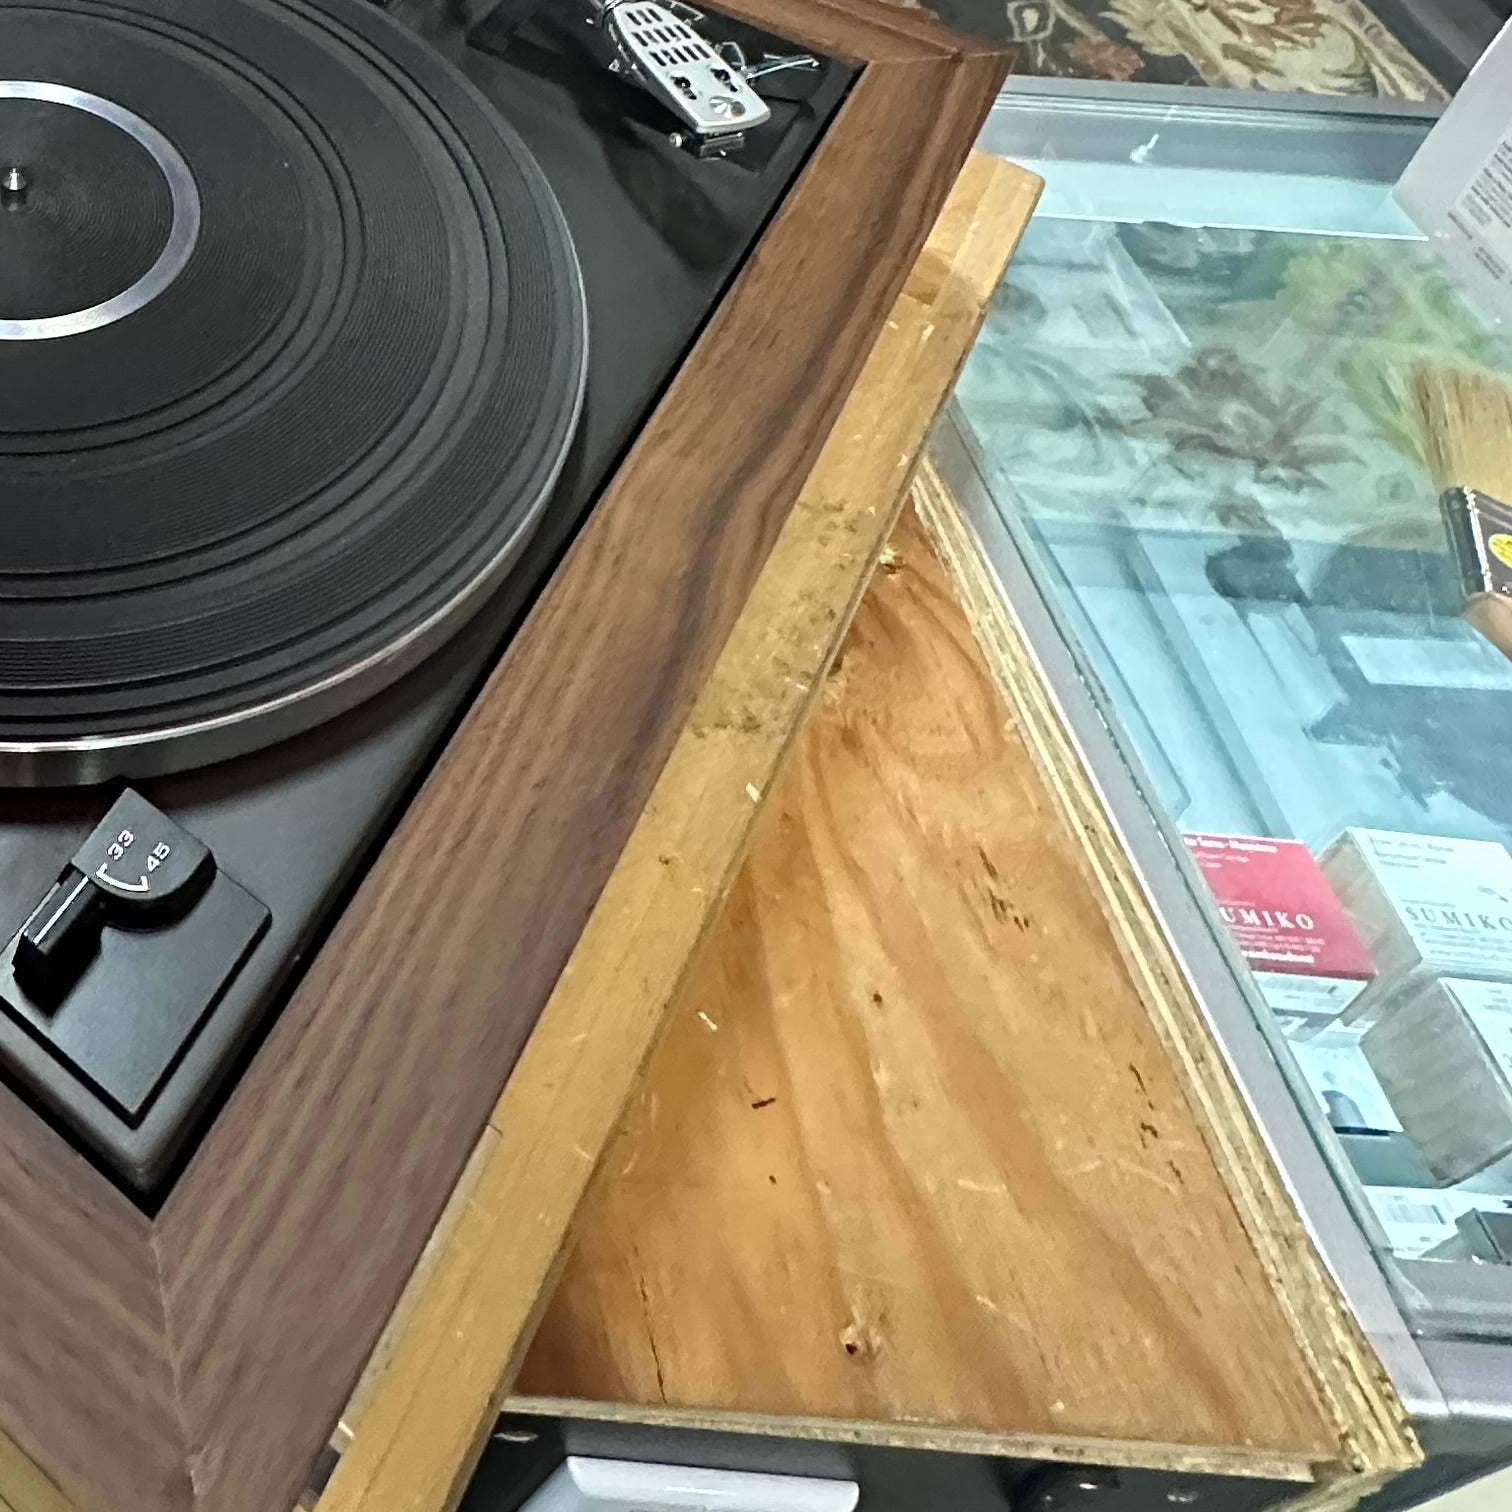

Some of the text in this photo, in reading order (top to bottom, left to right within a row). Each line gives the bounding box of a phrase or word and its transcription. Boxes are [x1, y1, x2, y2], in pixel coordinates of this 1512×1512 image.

[107, 829, 134, 861] 33
[147, 841, 171, 872] 45
[1219, 905, 1315, 931] UMIKO
[1404, 905, 1512, 935] SUMIKO
